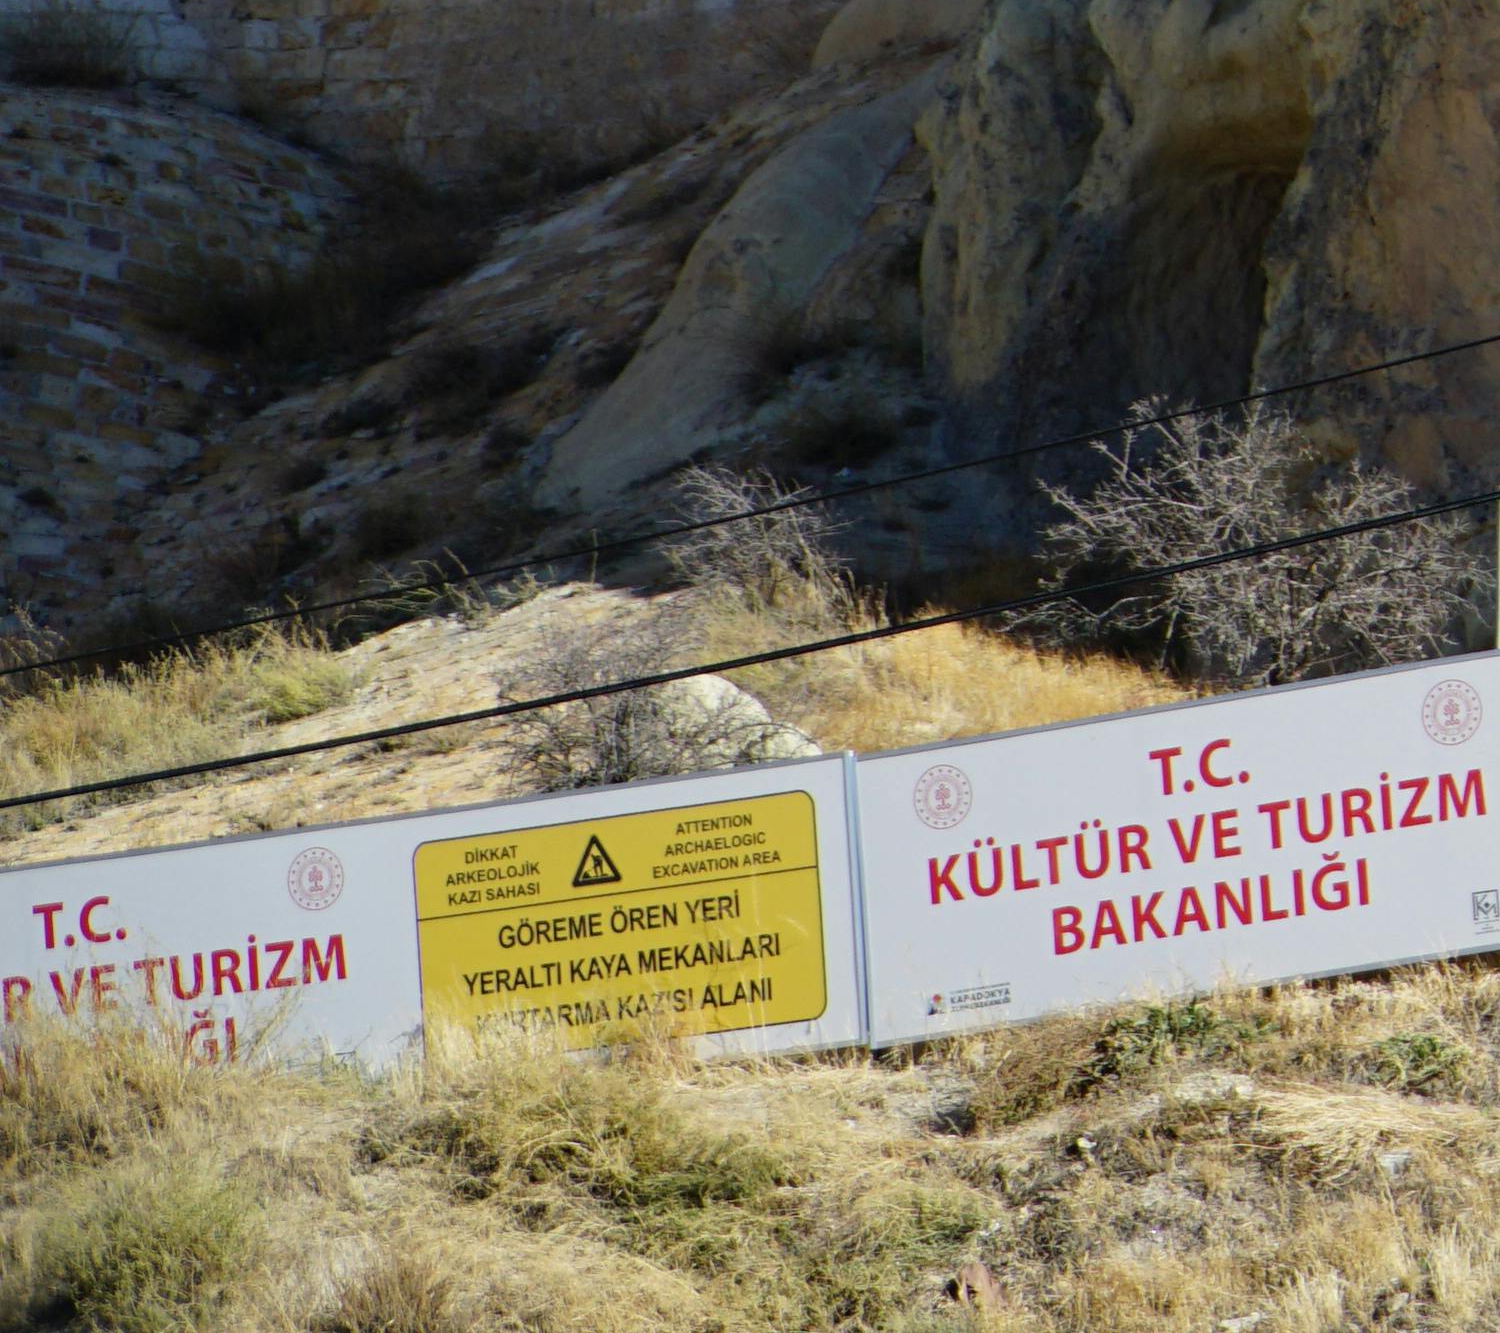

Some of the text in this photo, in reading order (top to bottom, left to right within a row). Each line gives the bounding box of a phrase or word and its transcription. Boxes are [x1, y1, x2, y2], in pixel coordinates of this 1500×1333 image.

[1149, 738, 1250, 794] T.C.
[665, 832, 765, 856] ARCHAELOGIC
[676, 814, 752, 835] ATTENTION
[929, 768, 1486, 904] KÜLTÜR VE TURİZM
[446, 861, 540, 886] ARKEOLOJİK
[465, 845, 517, 864] DİKKAT
[652, 851, 781, 879] EXCAVATION AREA
[448, 882, 540, 906] KAZI SAHASI
[1052, 852, 1369, 955] BAKANLIĞI
[32, 896, 127, 949] T.C.
[498, 889, 740, 949] GÖREME ÖREN YERİ
[49, 964, 119, 1016] VE
[133, 934, 348, 1007] TURİZM
[463, 933, 780, 996] YERALTI KAYA MEKANLARI
[701, 978, 773, 1010] ALANI
